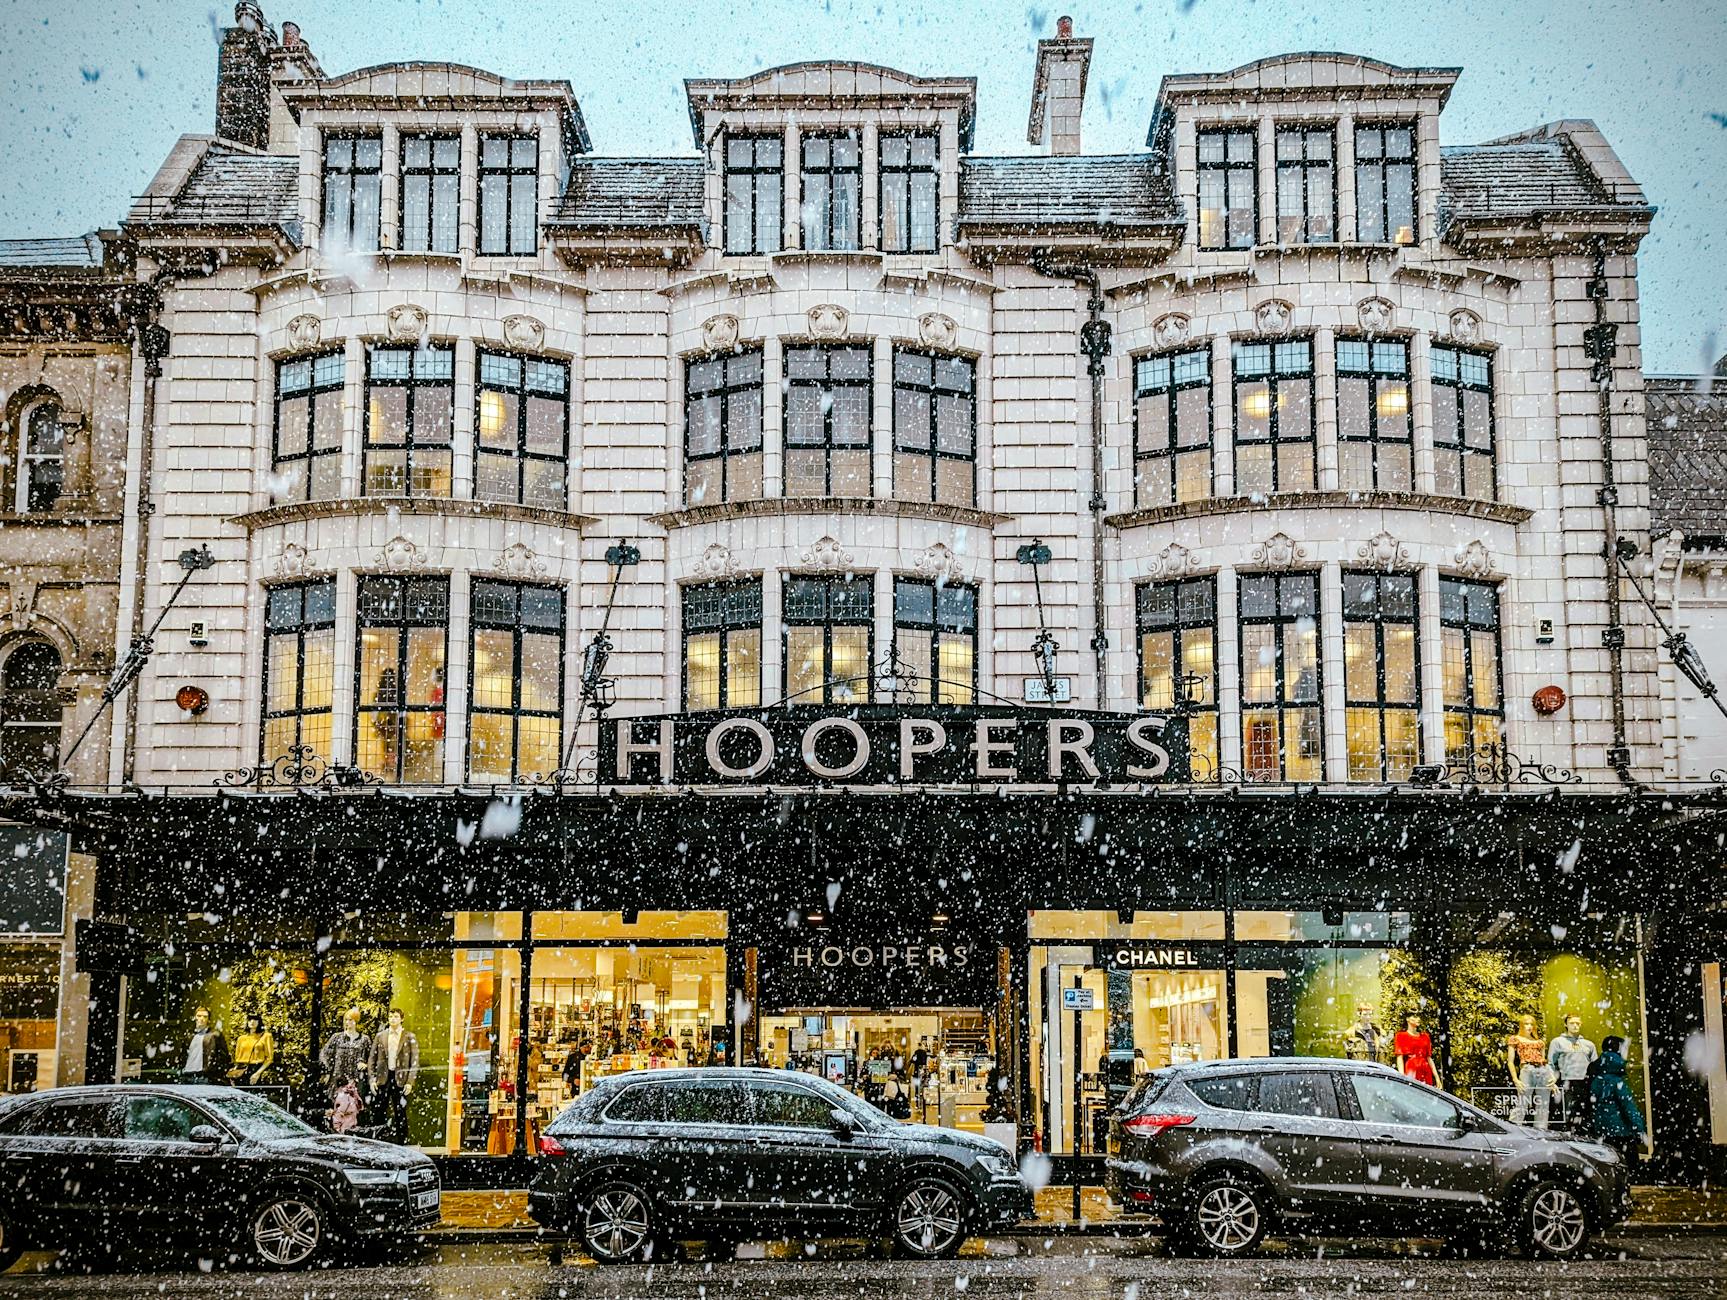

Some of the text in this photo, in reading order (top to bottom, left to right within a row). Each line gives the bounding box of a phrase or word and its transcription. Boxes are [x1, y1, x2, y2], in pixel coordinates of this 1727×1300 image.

[1031, 681, 1064, 690] JAES
[1029, 690, 1066, 699] STRET
[616, 717, 1170, 778] HOOPERS
[793, 946, 968, 967] HOOPERS
[1116, 950, 1198, 965] CHANEL
[1494, 1095, 1543, 1106] SPRING
[1491, 1106, 1547, 1116] colleions
